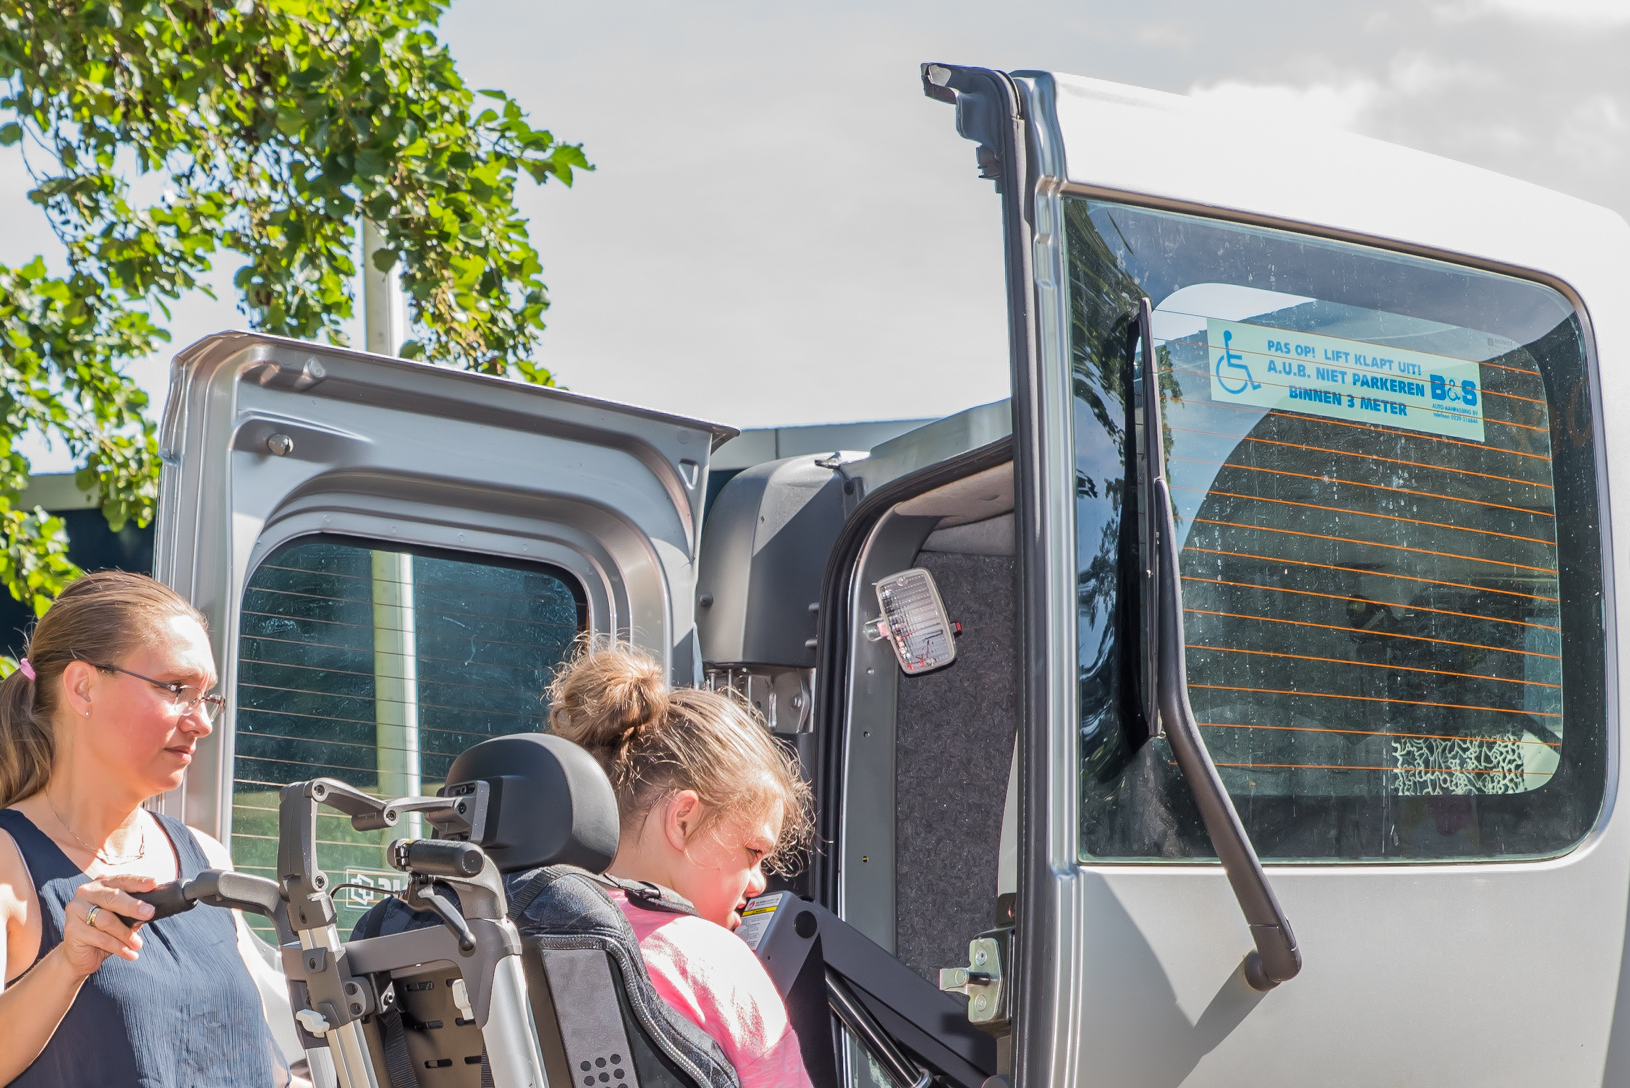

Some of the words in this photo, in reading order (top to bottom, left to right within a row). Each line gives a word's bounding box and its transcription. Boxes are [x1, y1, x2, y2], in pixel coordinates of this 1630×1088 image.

[1267, 340, 1291, 354] PAS
[1295, 344, 1316, 358] OP!
[1324, 349, 1350, 363] LIFT
[1354, 354, 1394, 371] KLAPT
[1398, 361, 1422, 376] UIT!
[1267, 359, 1311, 379] A.U.B.
[1315, 367, 1348, 385] NIET
[1352, 372, 1425, 397] PARKEREN
[1430, 374, 1478, 407] B&S
[1289, 385, 1342, 406] BINNEN
[1347, 394, 1355, 408] 3
[1360, 396, 1408, 417] METER
